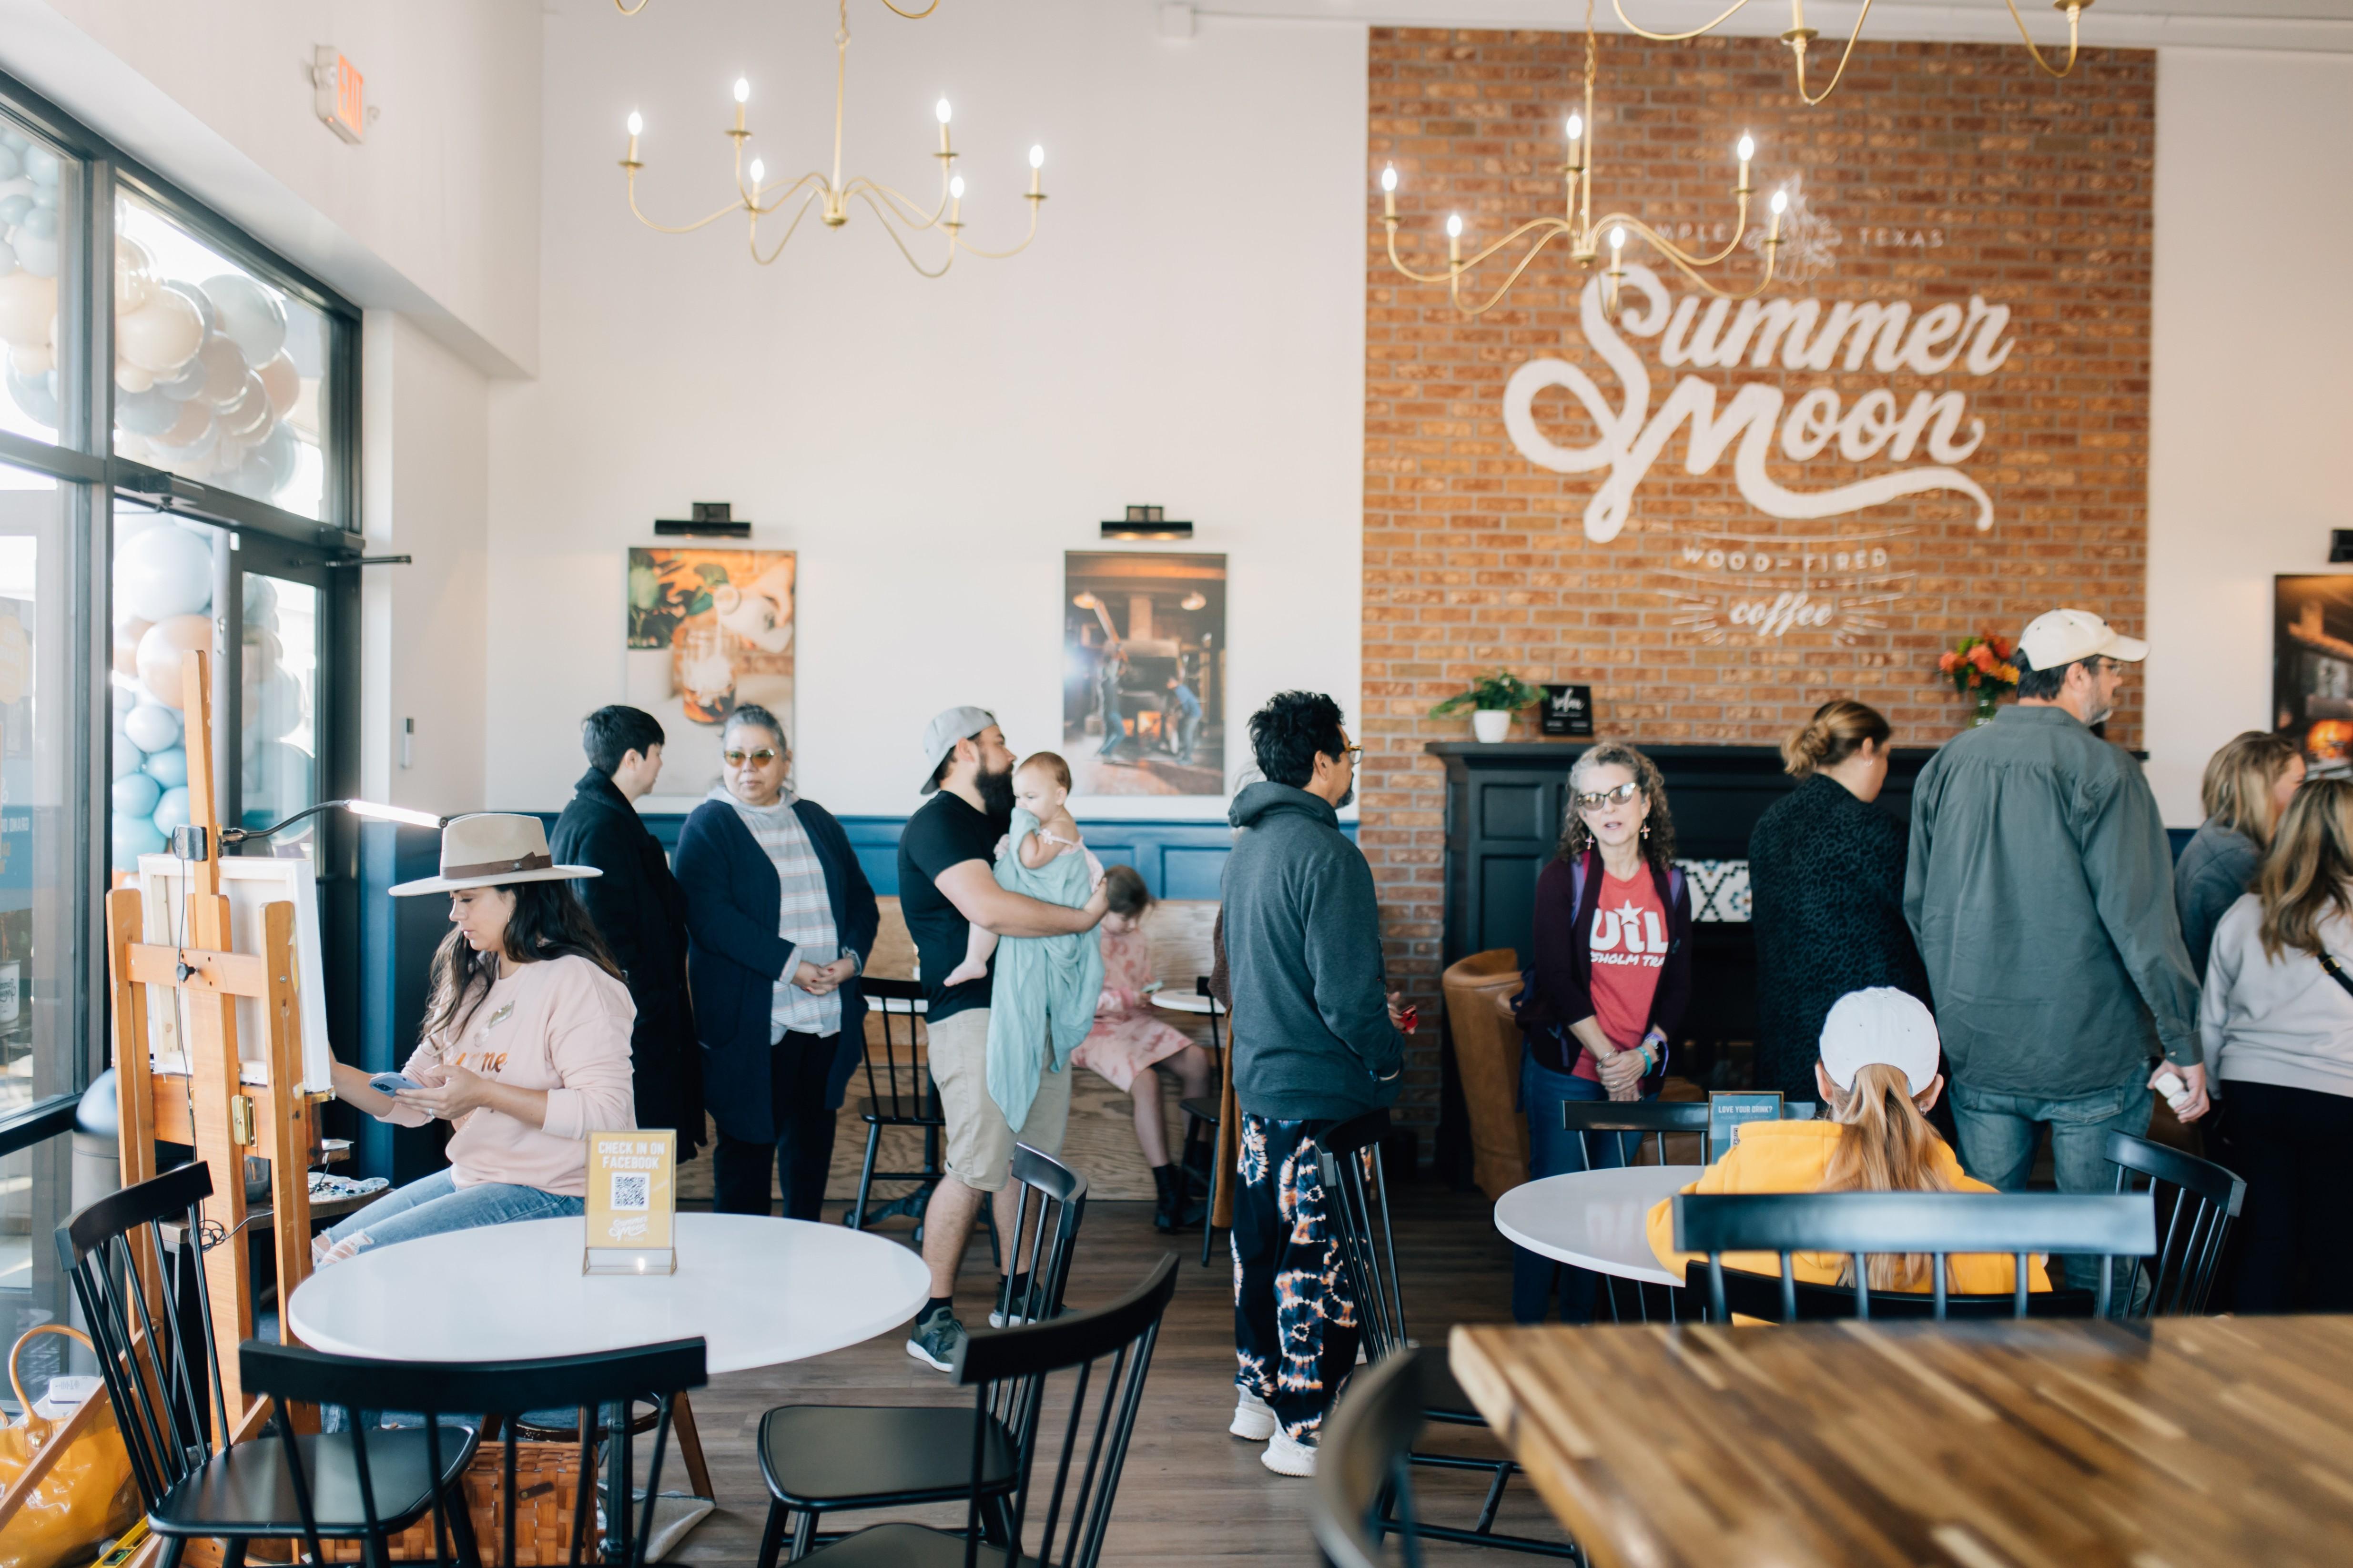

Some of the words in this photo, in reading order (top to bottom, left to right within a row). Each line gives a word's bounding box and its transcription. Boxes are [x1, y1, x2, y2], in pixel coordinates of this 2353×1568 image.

[337, 53, 364, 137] EXIT
[1636, 222, 1727, 242] MPLE
[1859, 226, 1945, 248] TEXAS
[1583, 374, 1994, 543] Moon
[1730, 591, 1833, 637] coffee
[1590, 951, 1640, 966] SHOLM
[1643, 955, 1665, 968] TRA
[1718, 1105, 1734, 1113] LOVE
[1735, 1105, 1750, 1113] YOUR
[1752, 1105, 1773, 1113] DRINK?
[598, 1142, 633, 1154] CHECK
[636, 1142, 648, 1155] IN
[650, 1142, 665, 1155] ON
[602, 1156, 660, 1170] FACEBOOK
